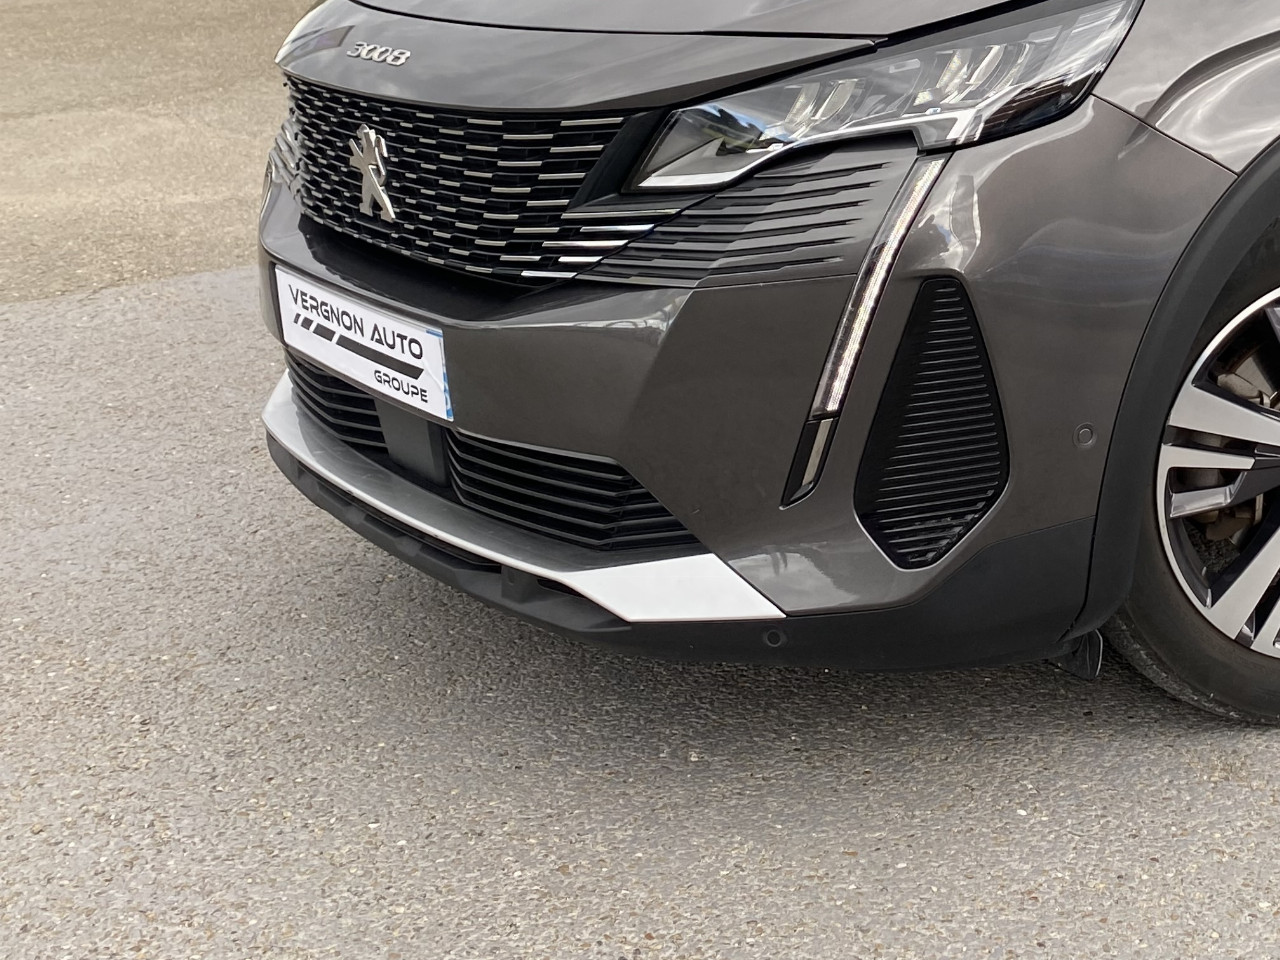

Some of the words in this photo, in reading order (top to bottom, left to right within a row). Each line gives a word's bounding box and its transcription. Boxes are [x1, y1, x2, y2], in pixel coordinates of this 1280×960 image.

[346, 41, 411, 66] 3008
[289, 285, 364, 336] VERGNON
[370, 323, 423, 360] AUTO
[373, 369, 429, 403] GROUPE
